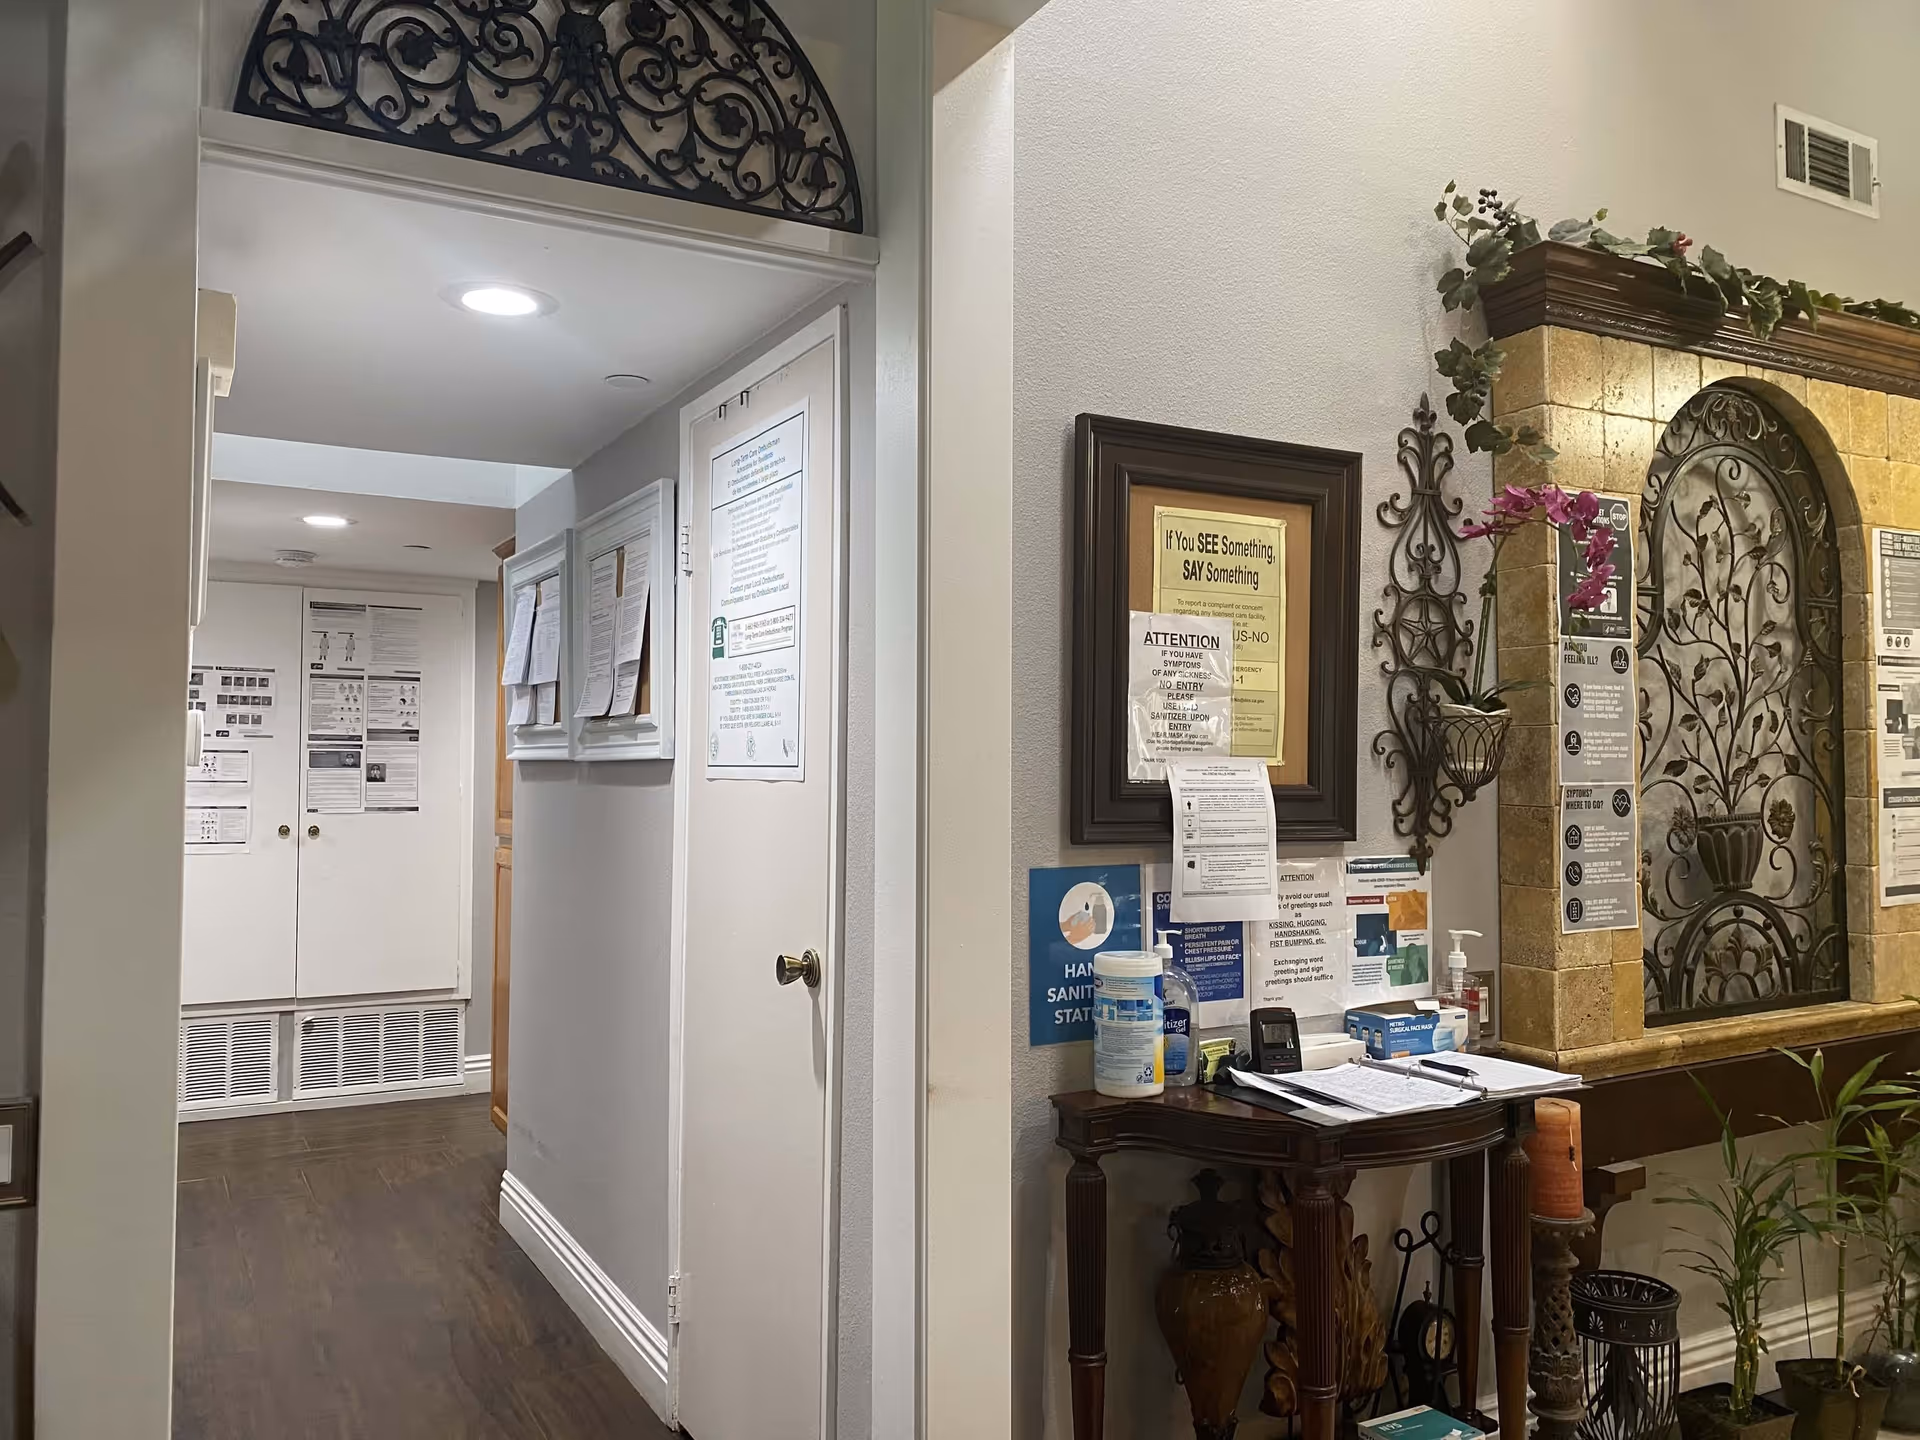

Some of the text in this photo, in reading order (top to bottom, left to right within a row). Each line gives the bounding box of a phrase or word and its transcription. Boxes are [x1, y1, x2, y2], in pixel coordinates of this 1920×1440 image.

[1612, 513, 1627, 521] STOP
[1166, 529, 1276, 565] If You SEE Something,
[1183, 559, 1259, 591] SAY Something
[1185, 600, 1201, 608] report
[1208, 602, 1234, 610] complaint
[1173, 608, 1199, 616] regarding
[1144, 632, 1220, 649] ATTENTION
[1186, 652, 1203, 660] HAVE
[1565, 654, 1598, 665] FEELING ILL?
[1164, 660, 1201, 669] SYMPTOMS
[1163, 670, 1177, 678] ANY
[1178, 671, 1212, 680] SICKNESS
[1160, 680, 1204, 691] NO ENTRY
[1167, 693, 1195, 701] PLEASE
[1163, 702, 1177, 710] USE
[1151, 712, 1210, 721] SANITIZER UPON
[1168, 723, 1192, 731] ENTRY
[1566, 788, 1593, 798] SYPTOMS?
[1566, 800, 1604, 810] WHERE TO GO?
[1280, 874, 1315, 882] ATTENTION
[1291, 902, 1318, 910] greetings
[1269, 918, 1327, 929] KISSING, HUGGING,
[1275, 929, 1321, 937] HANDSHAKING,
[1270, 940, 1283, 948] FIST
[1285, 938, 1314, 947] BUMPING,
[1274, 957, 1308, 966] Exchanging
[1274, 967, 1298, 977] greeting
[1311, 965, 1323, 973] sign
[1265, 977, 1292, 987] greetings
[1294, 975, 1312, 983] should
